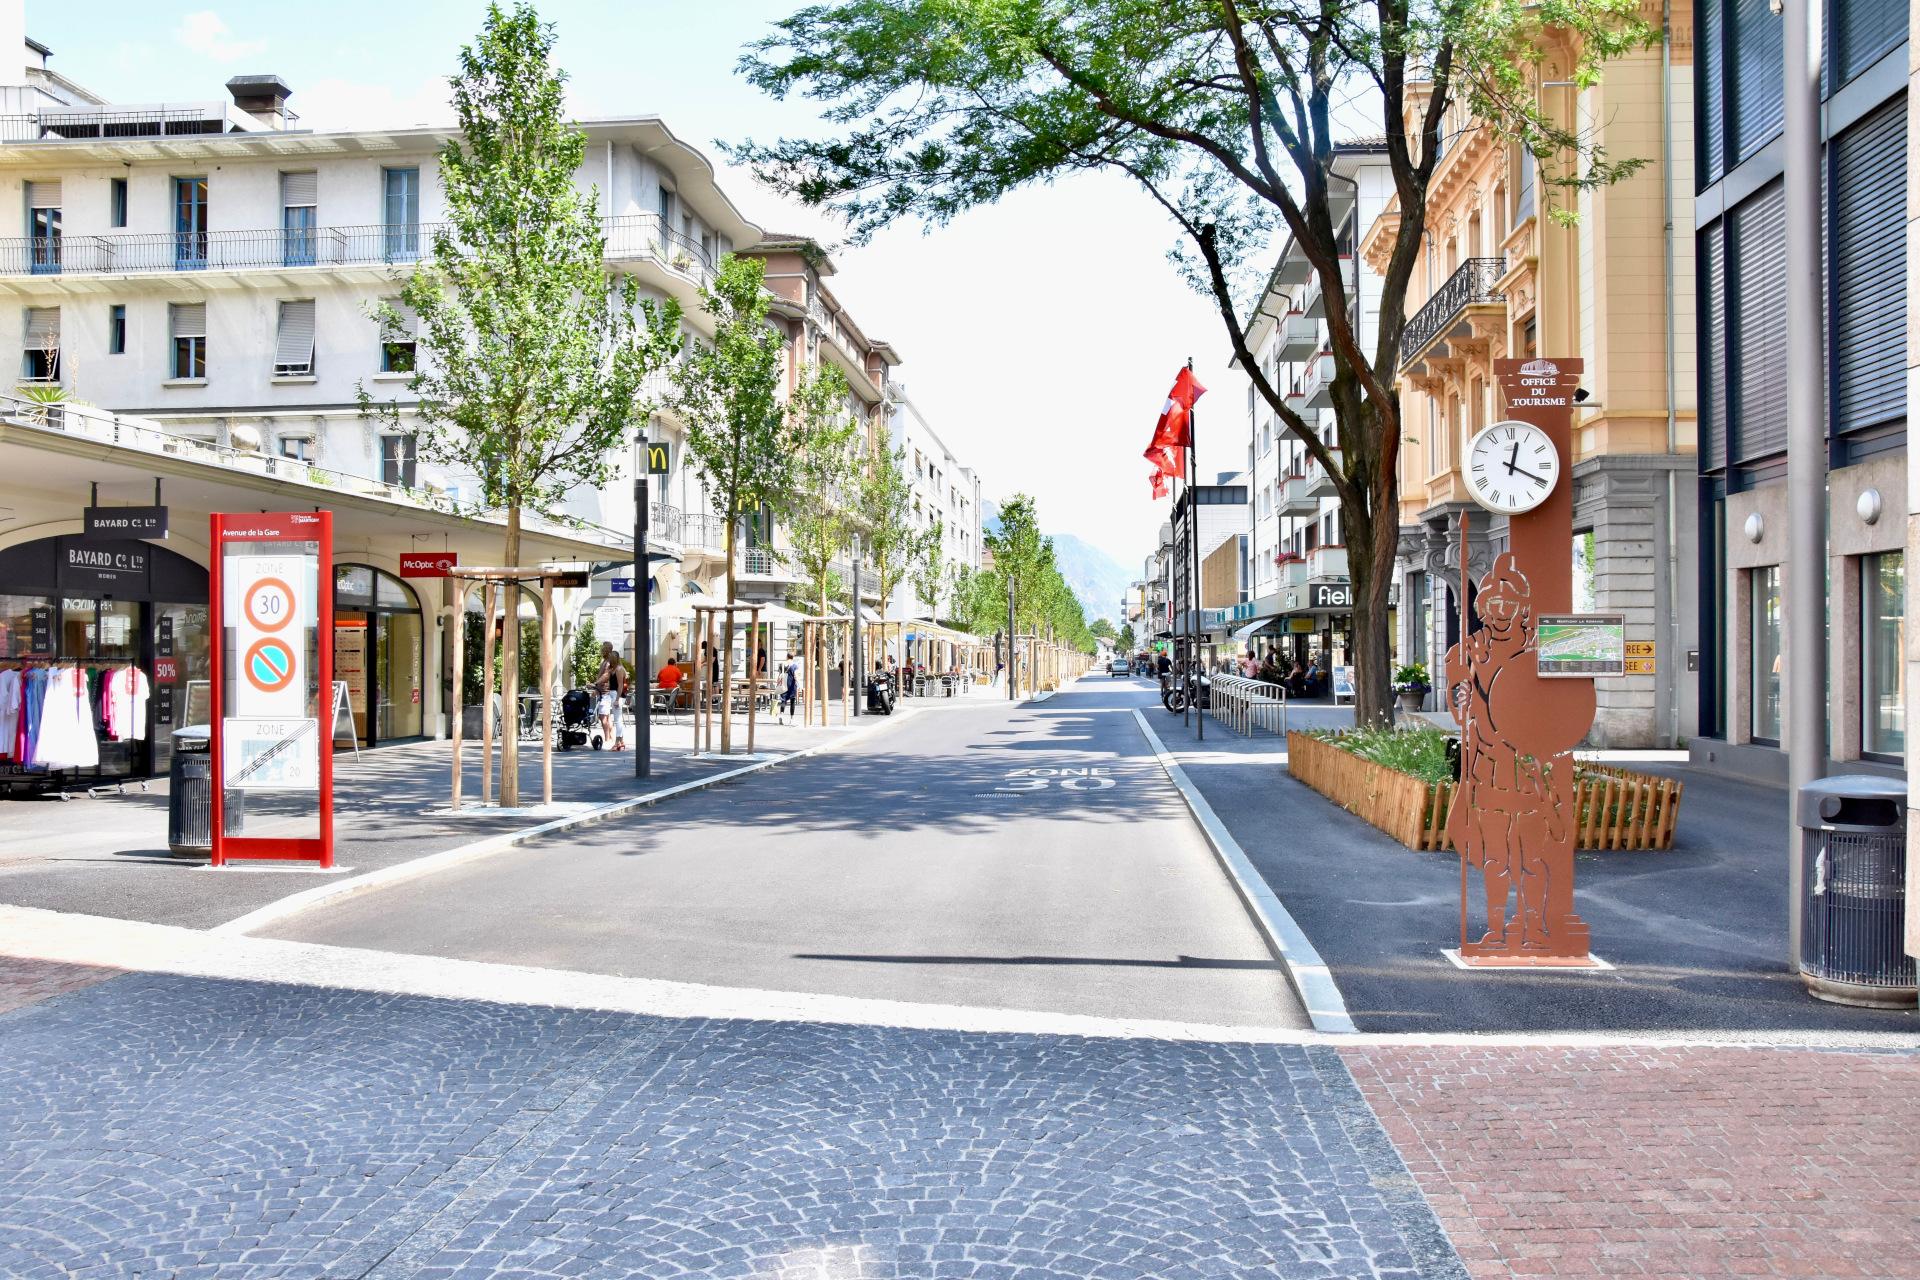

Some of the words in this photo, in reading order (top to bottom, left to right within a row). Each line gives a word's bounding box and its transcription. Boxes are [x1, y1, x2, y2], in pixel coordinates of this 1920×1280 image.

[1521, 378, 1556, 386] OFFICE
[1531, 388, 1546, 396] DU
[1512, 398, 1566, 406] TOURISME
[94, 519, 128, 528] BAYARD
[69, 549, 112, 566] BAYARD
[255, 562, 283, 574] ZONE
[403, 560, 433, 569] McOptic
[1318, 586, 1353, 605] fiel
[260, 595, 280, 615] 30
[1626, 645, 1641, 654] REE
[157, 664, 176, 677] 50%
[1625, 661, 1638, 670] SEE
[256, 724, 285, 735] ZONE
[289, 766, 300, 777] 20
[1004, 767, 1112, 777] ZONE
[995, 777, 1116, 791] 30
